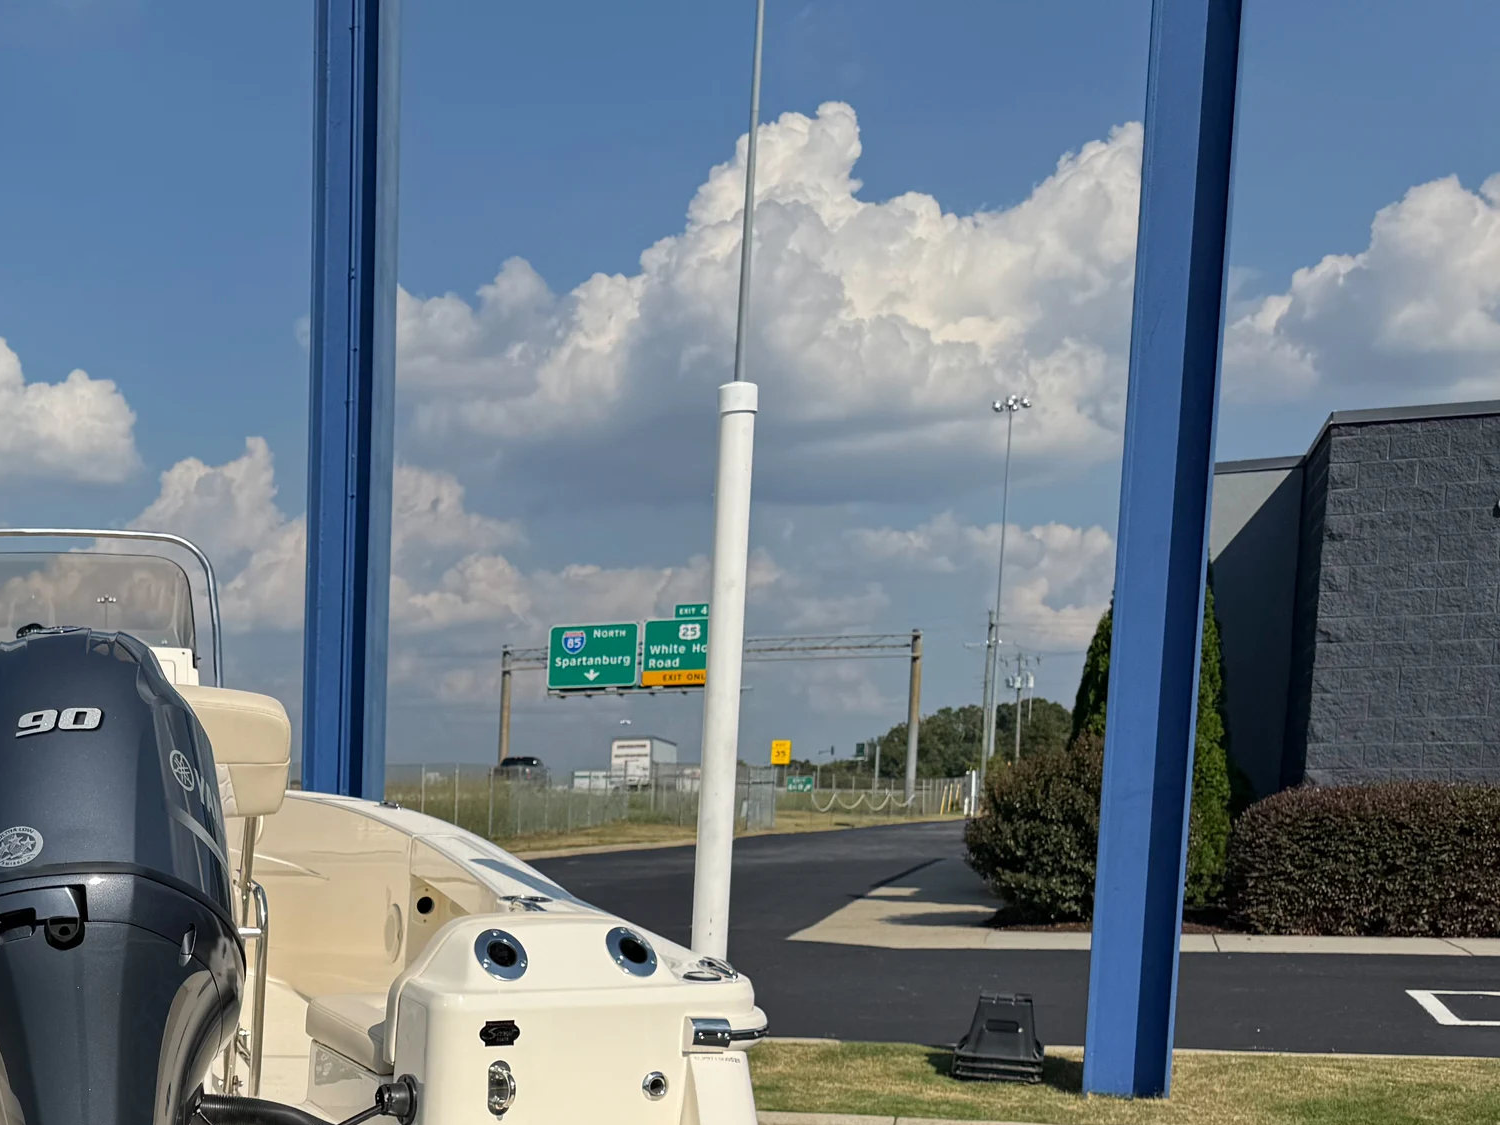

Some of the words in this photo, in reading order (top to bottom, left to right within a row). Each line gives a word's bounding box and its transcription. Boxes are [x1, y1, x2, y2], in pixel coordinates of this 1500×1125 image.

[679, 607, 696, 615] EXIT
[681, 626, 698, 638] 25
[566, 638, 582, 649] 85
[649, 644, 686, 655] White
[554, 655, 631, 669] Spartanburg
[648, 657, 680, 669] Road
[662, 673, 682, 682] EXIT
[686, 672, 706, 681] ONL
[15, 707, 102, 738] 90
